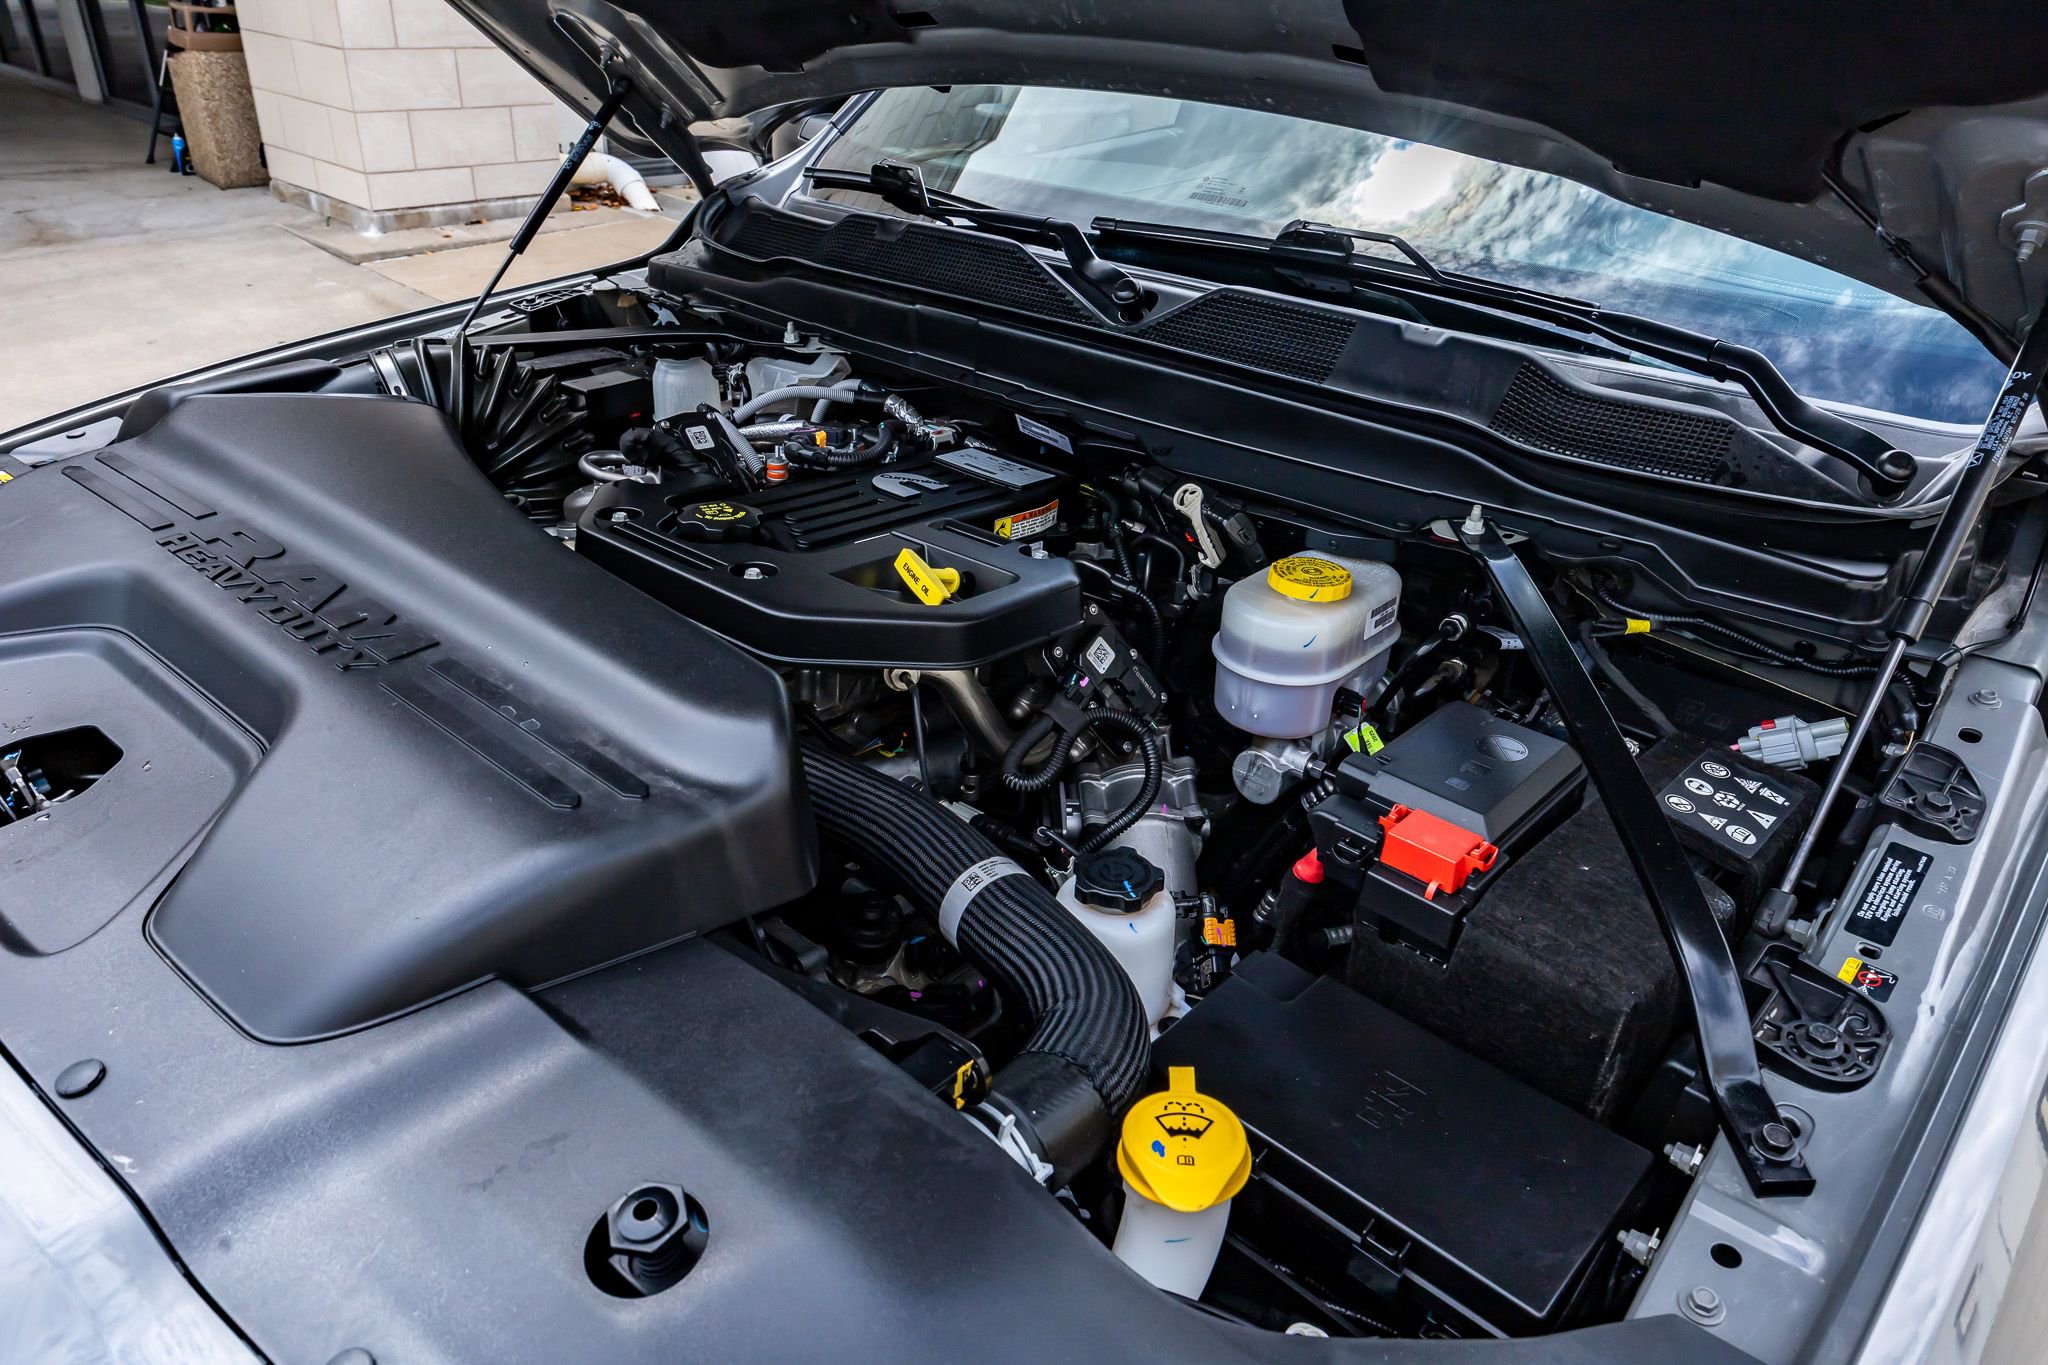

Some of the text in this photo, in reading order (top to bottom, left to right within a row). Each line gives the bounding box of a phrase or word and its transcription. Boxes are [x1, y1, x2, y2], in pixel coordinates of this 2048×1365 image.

[2012, 371, 2032, 380] DY
[189, 519, 441, 664] RAM
[903, 562, 930, 597] ENGINE OIL
[155, 533, 380, 671] HEAVY DUTY
[1876, 872, 1886, 881] than
[1882, 857, 1893, 872] nominal
[1865, 910, 1873, 919] 12V
[1873, 886, 1886, 905] electrical
[1883, 872, 1894, 886] system
[1890, 860, 1902, 874] during
[1866, 891, 1876, 903] apply
[1872, 881, 1881, 892] more
[1875, 900, 1889, 919] charging
[1886, 884, 1896, 895] jump
[1881, 869, 1912, 921] Engine and starting system
[1891, 903, 1903, 917] failure
[1900, 891, 1909, 903] could
